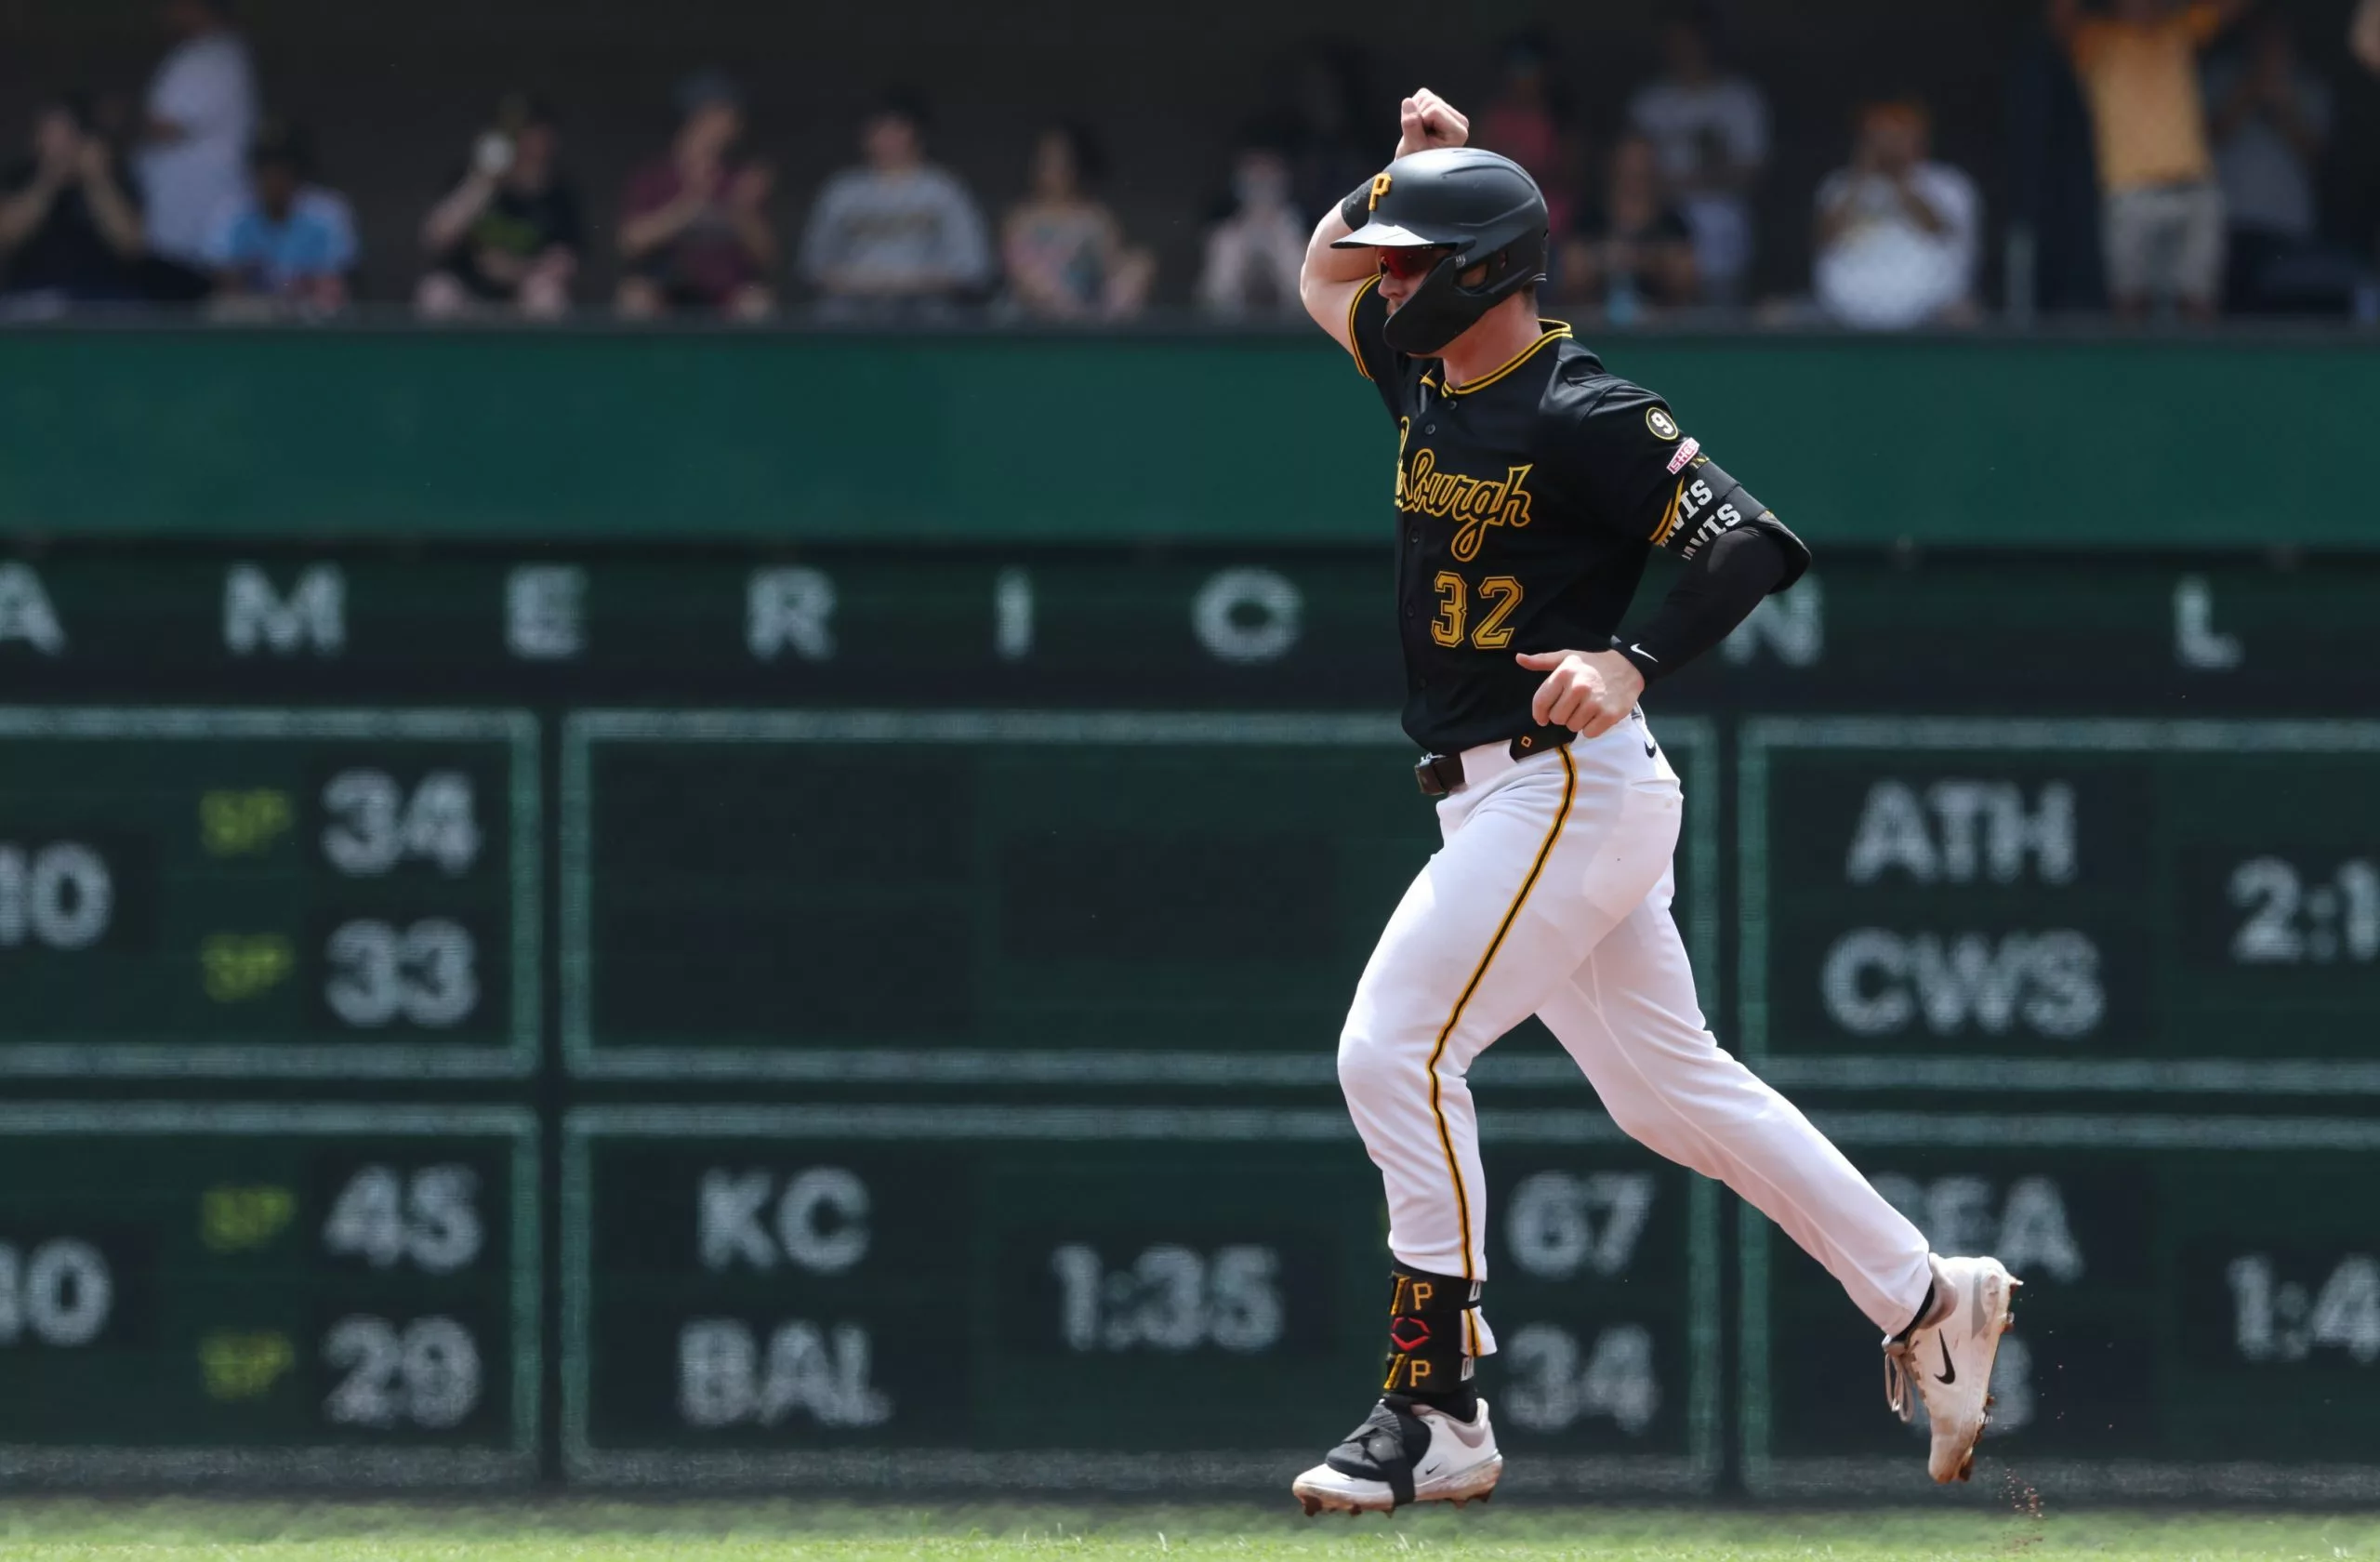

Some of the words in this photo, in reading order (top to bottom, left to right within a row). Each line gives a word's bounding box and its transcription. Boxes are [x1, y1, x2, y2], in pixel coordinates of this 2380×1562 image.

[1368, 172, 1393, 212] P
[1651, 411, 1674, 435] 9
[1659, 479, 1712, 547] VIS
[1682, 503, 1741, 561] VIS
[1431, 570, 1524, 650] 32
[324, 770, 480, 876] 34
[1846, 781, 2077, 883] ATH
[327, 920, 479, 1026] 33
[1822, 929, 2105, 1036] CWS
[324, 1164, 482, 1273] 45
[699, 1168, 868, 1272] KC
[1506, 1170, 1657, 1278] 67
[0, 1238, 112, 1345] 0
[1051, 1245, 1283, 1351] 1:35
[1412, 1282, 1434, 1311] P
[325, 1316, 482, 1428] 29
[679, 1319, 891, 1426] BAL
[1409, 1359, 1432, 1387] P
[1504, 1324, 1659, 1432] 34
